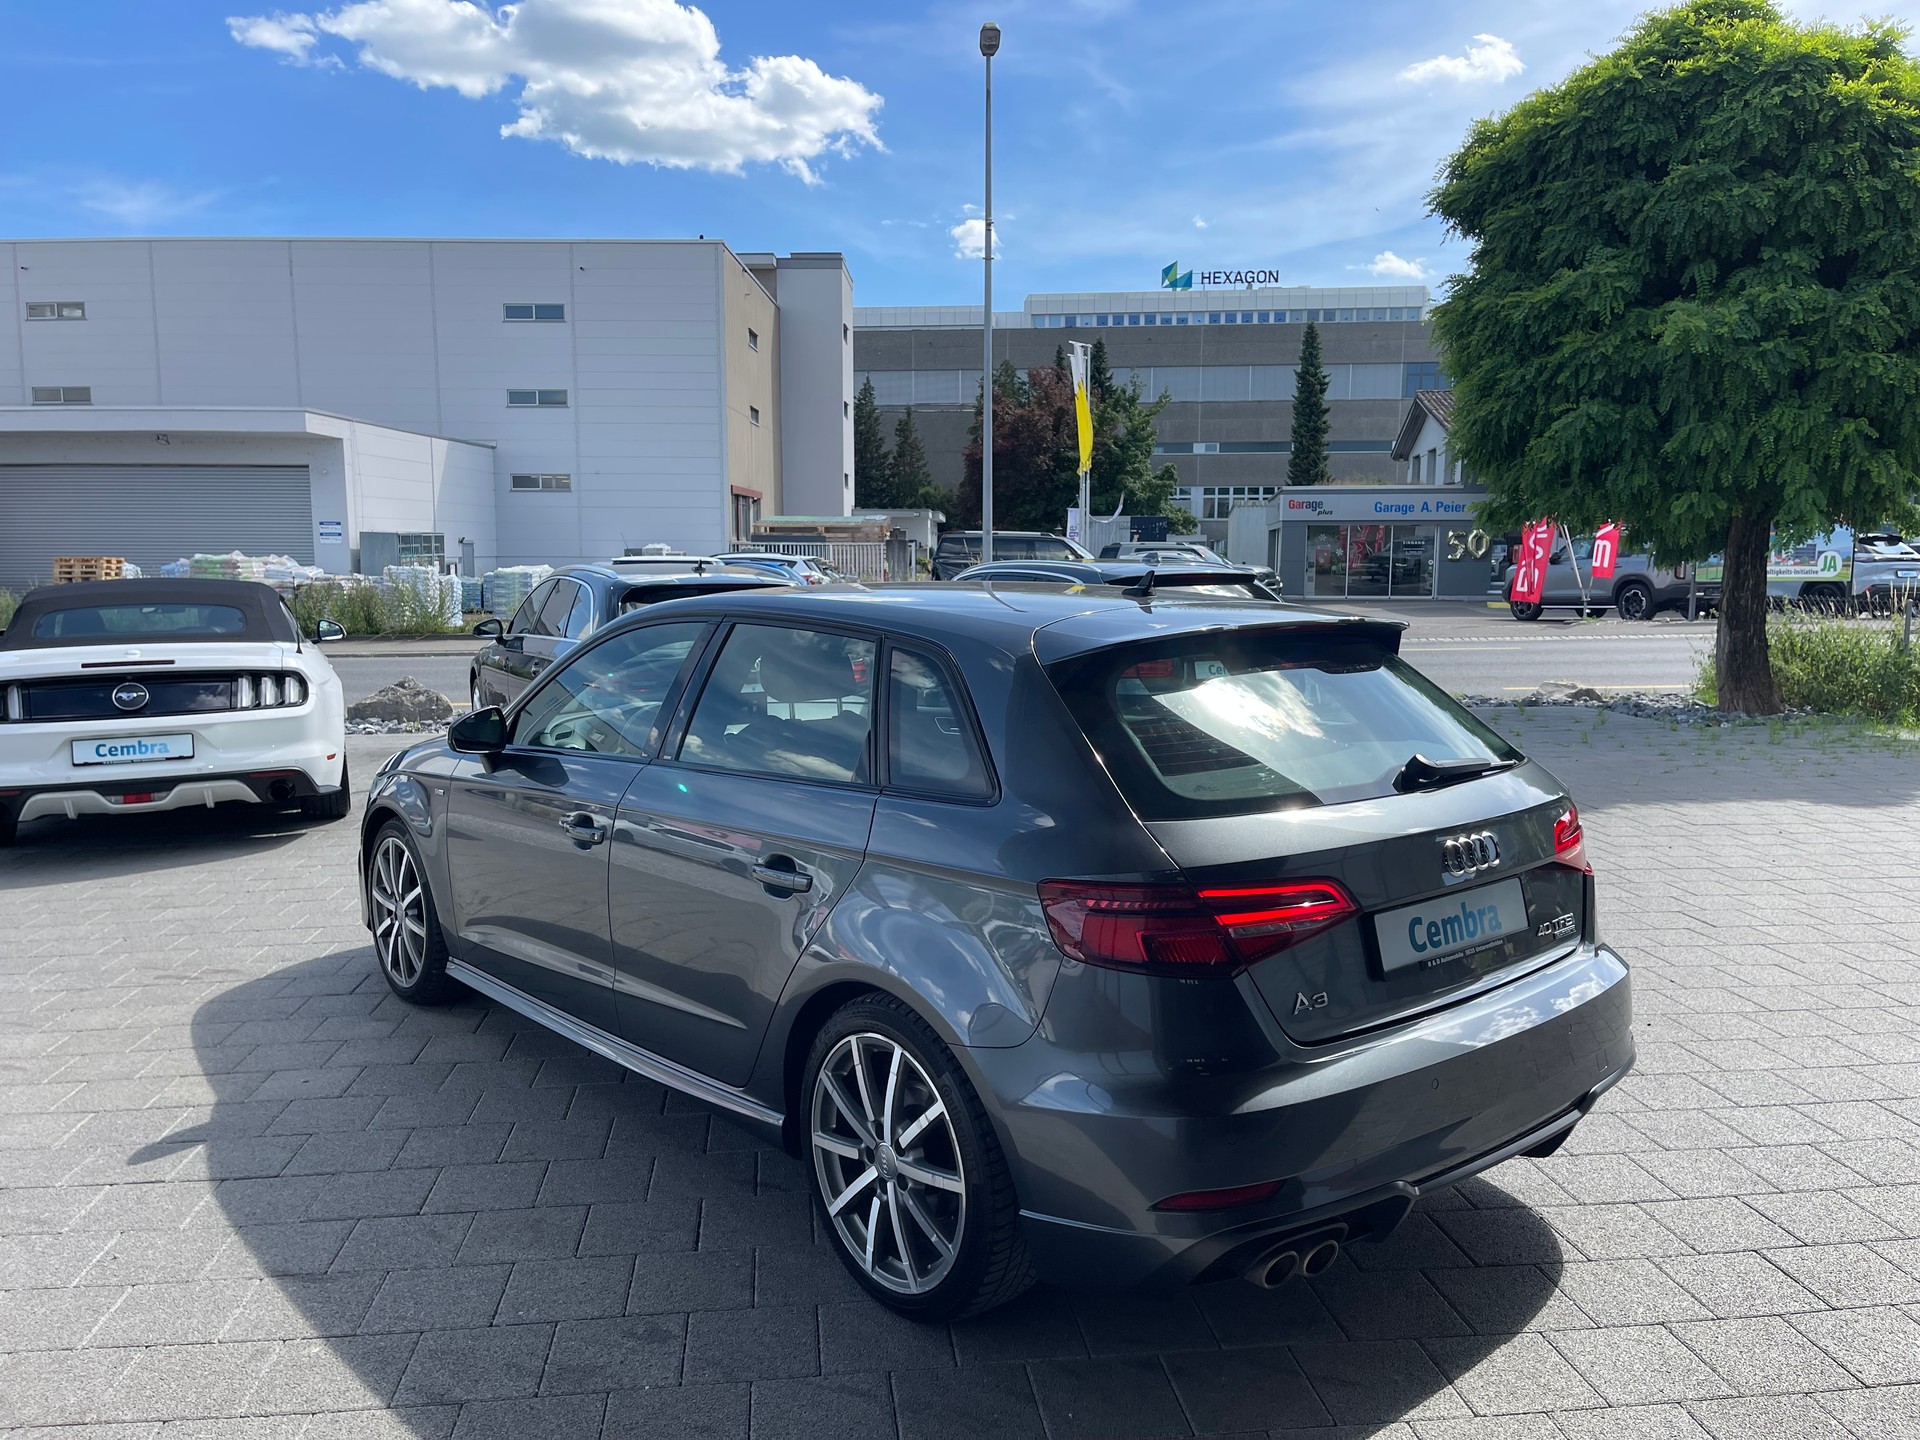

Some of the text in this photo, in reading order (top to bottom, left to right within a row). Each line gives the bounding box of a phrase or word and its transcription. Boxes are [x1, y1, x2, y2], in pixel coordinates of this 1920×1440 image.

[1200, 270, 1280, 286] HEXAGON
[1288, 499, 1324, 512] Garage
[1374, 501, 1467, 515] Garage A. Peier
[1820, 555, 1838, 572] JA
[95, 740, 170, 758] Cembra
[1408, 901, 1502, 953] Cembra
[1294, 991, 1328, 1015] A3
